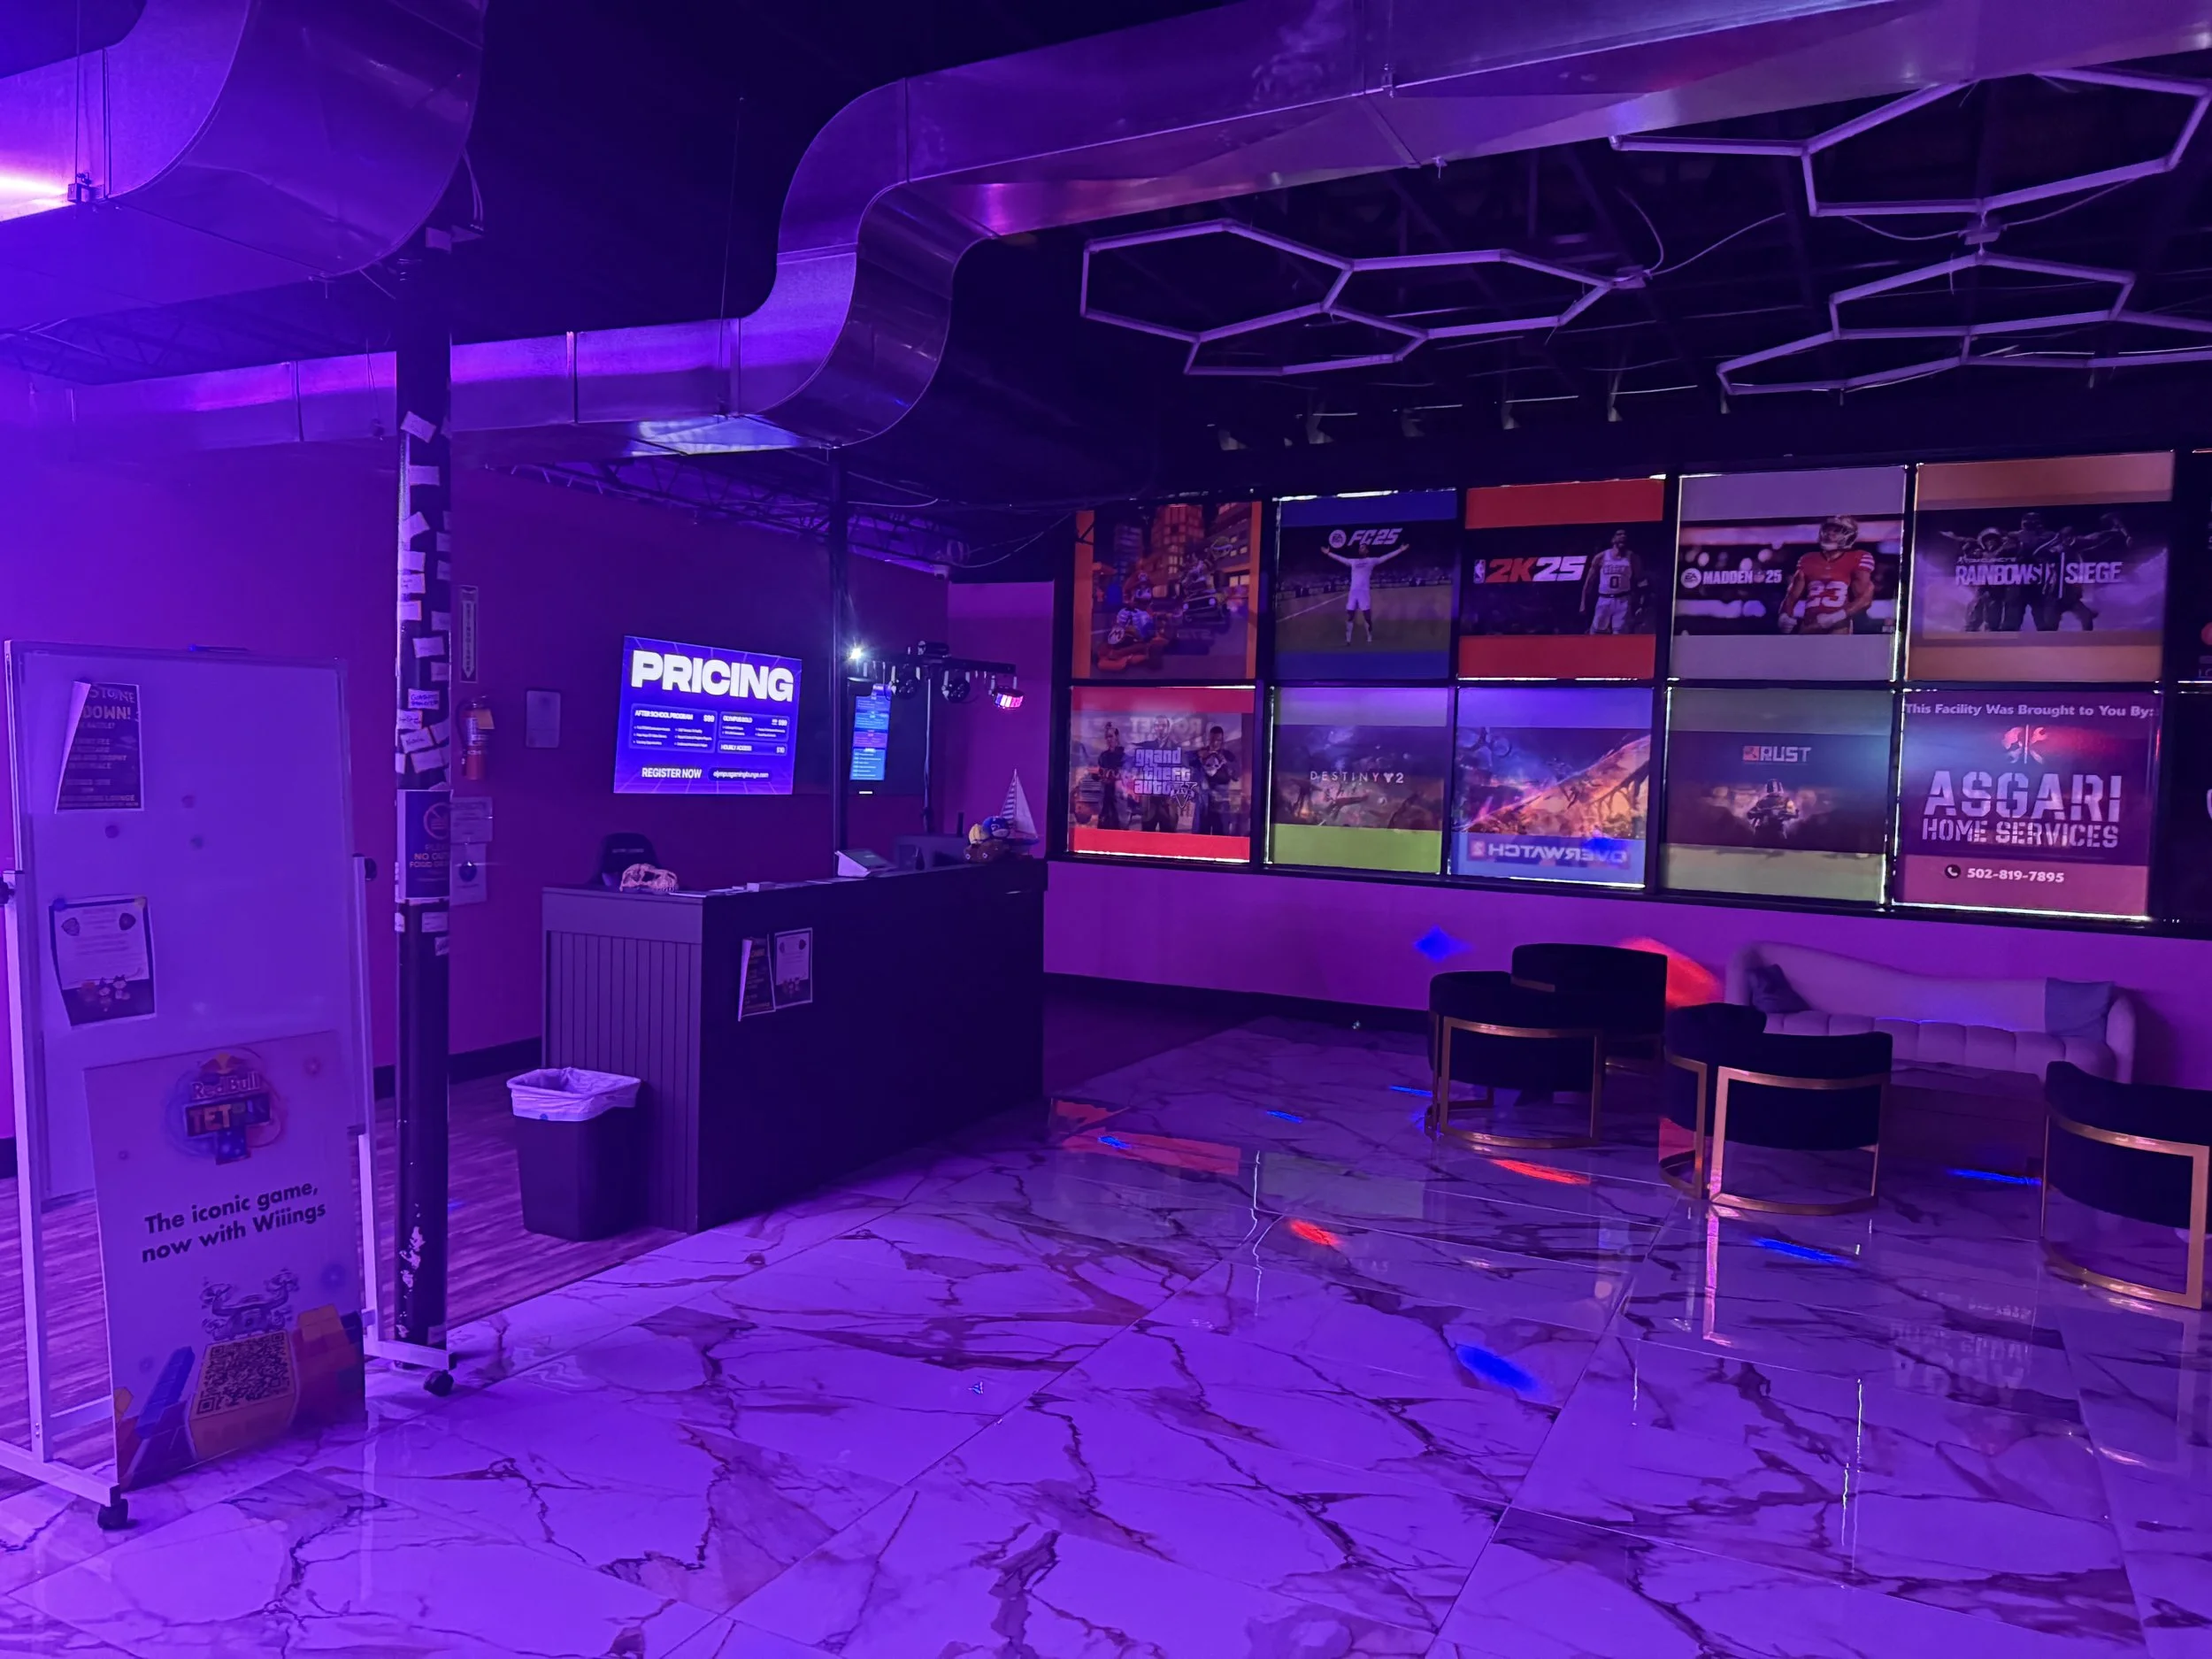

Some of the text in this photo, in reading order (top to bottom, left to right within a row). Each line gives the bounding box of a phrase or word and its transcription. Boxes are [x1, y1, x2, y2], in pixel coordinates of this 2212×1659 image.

[1485, 556, 1588, 583] 2K25
[1702, 571, 1753, 585] MADDEN
[1765, 569, 1782, 584] 25
[1955, 564, 2032, 586] RAINBOW
[2064, 562, 2124, 584] SIEGE
[1805, 580, 1849, 608] 23
[631, 649, 795, 702] PRICING
[1906, 703, 2154, 719] This Facility Was Brought to You By:
[1135, 747, 1182, 767] grand
[1760, 746, 1812, 763] RUST
[641, 767, 680, 778] REGISTER
[682, 768, 702, 779] NOW
[1142, 764, 1191, 781] theft
[1310, 771, 1404, 784] DESTINY 2
[1134, 780, 1172, 795] auto
[1924, 770, 2123, 823] ASGARI
[1922, 818, 2119, 849] HOME SERVICES
[1967, 867, 2065, 883] 502-819-7895
[190, 1071, 261, 1101] Red Bull
[144, 1182, 319, 1234] The iconic game,
[142, 1203, 326, 1263] now with Wiiings
